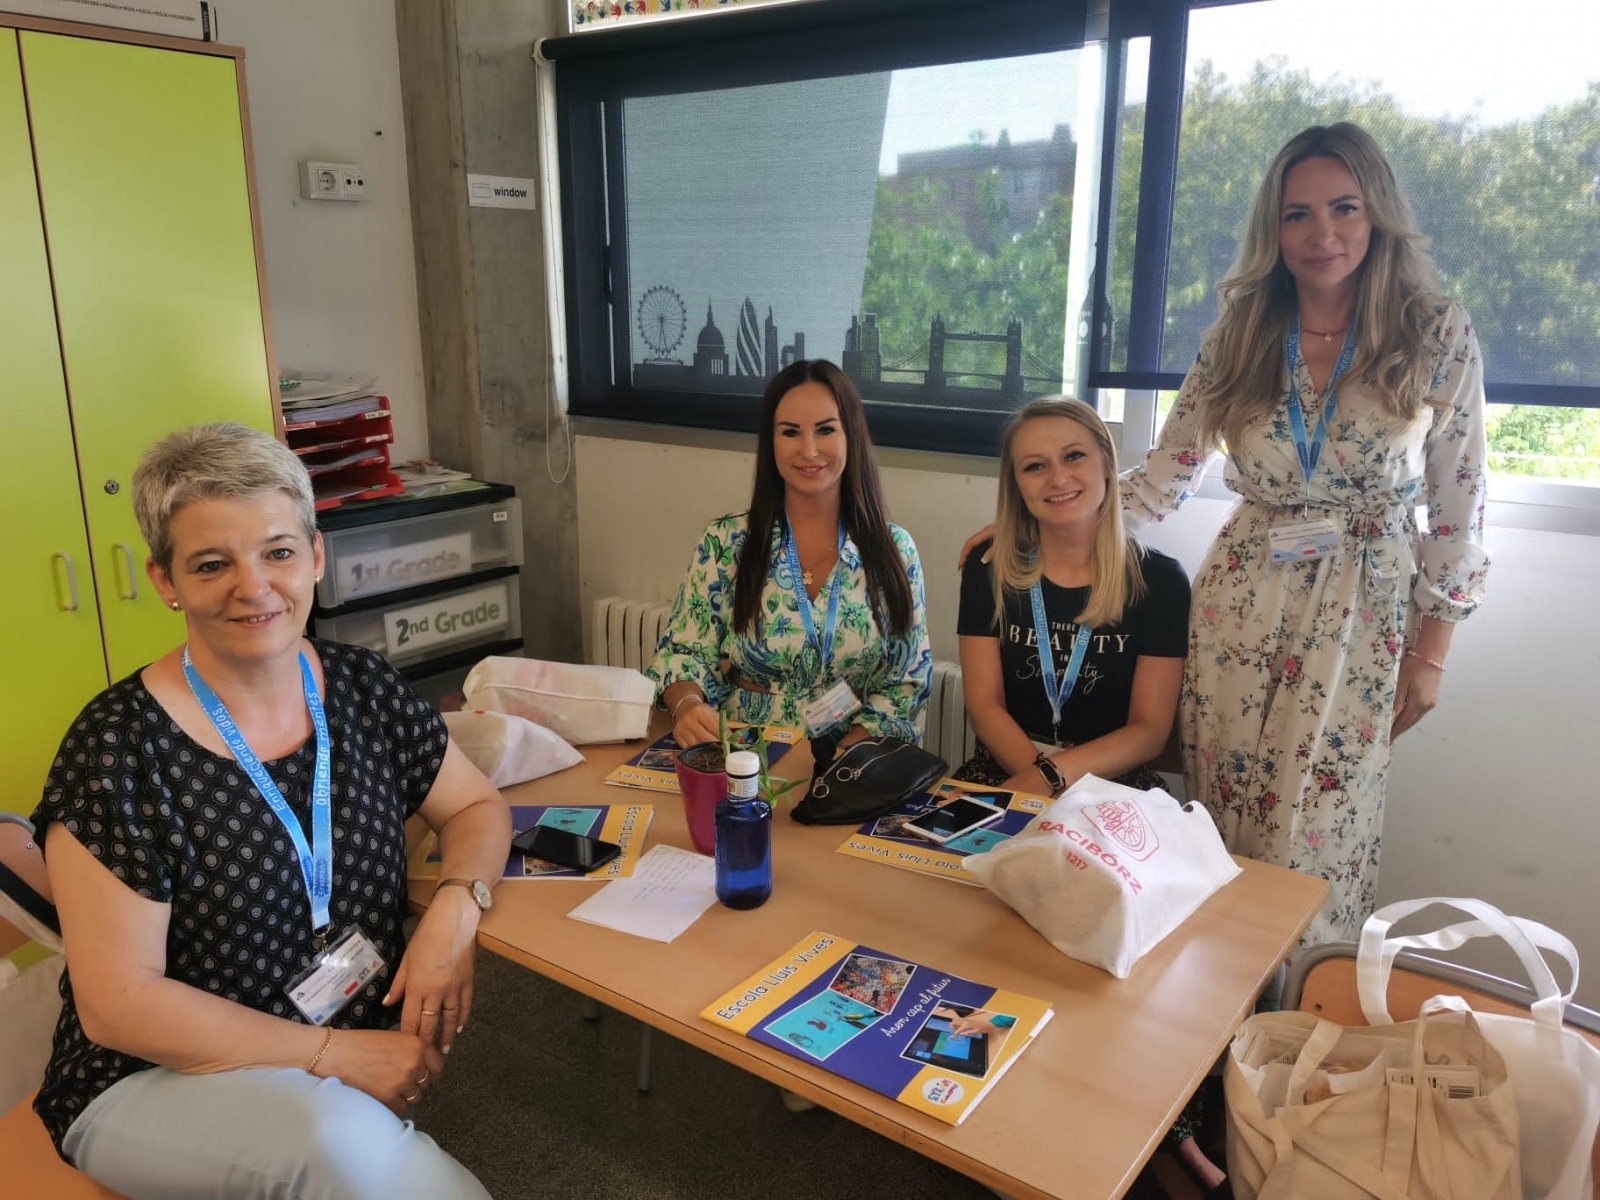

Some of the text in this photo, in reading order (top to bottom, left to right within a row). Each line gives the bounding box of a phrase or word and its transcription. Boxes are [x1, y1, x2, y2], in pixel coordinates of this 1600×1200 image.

[494, 186, 527, 198] window
[387, 550, 460, 582] Grade
[395, 600, 500, 647] 2nd Grade
[1052, 621, 1076, 632] THERE
[1060, 653, 1070, 663] IN
[232, 738, 286, 812] Enriqueciendo
[316, 745, 330, 806] abriendo
[623, 806, 642, 831] Escola
[848, 842, 889, 857] Vives
[1038, 820, 1143, 895] RACIBÓRZ
[1066, 851, 1089, 871] 1217
[716, 985, 769, 1020] Escola
[793, 938, 834, 964] Vives
[880, 977, 951, 1038] Anem cap al futur
